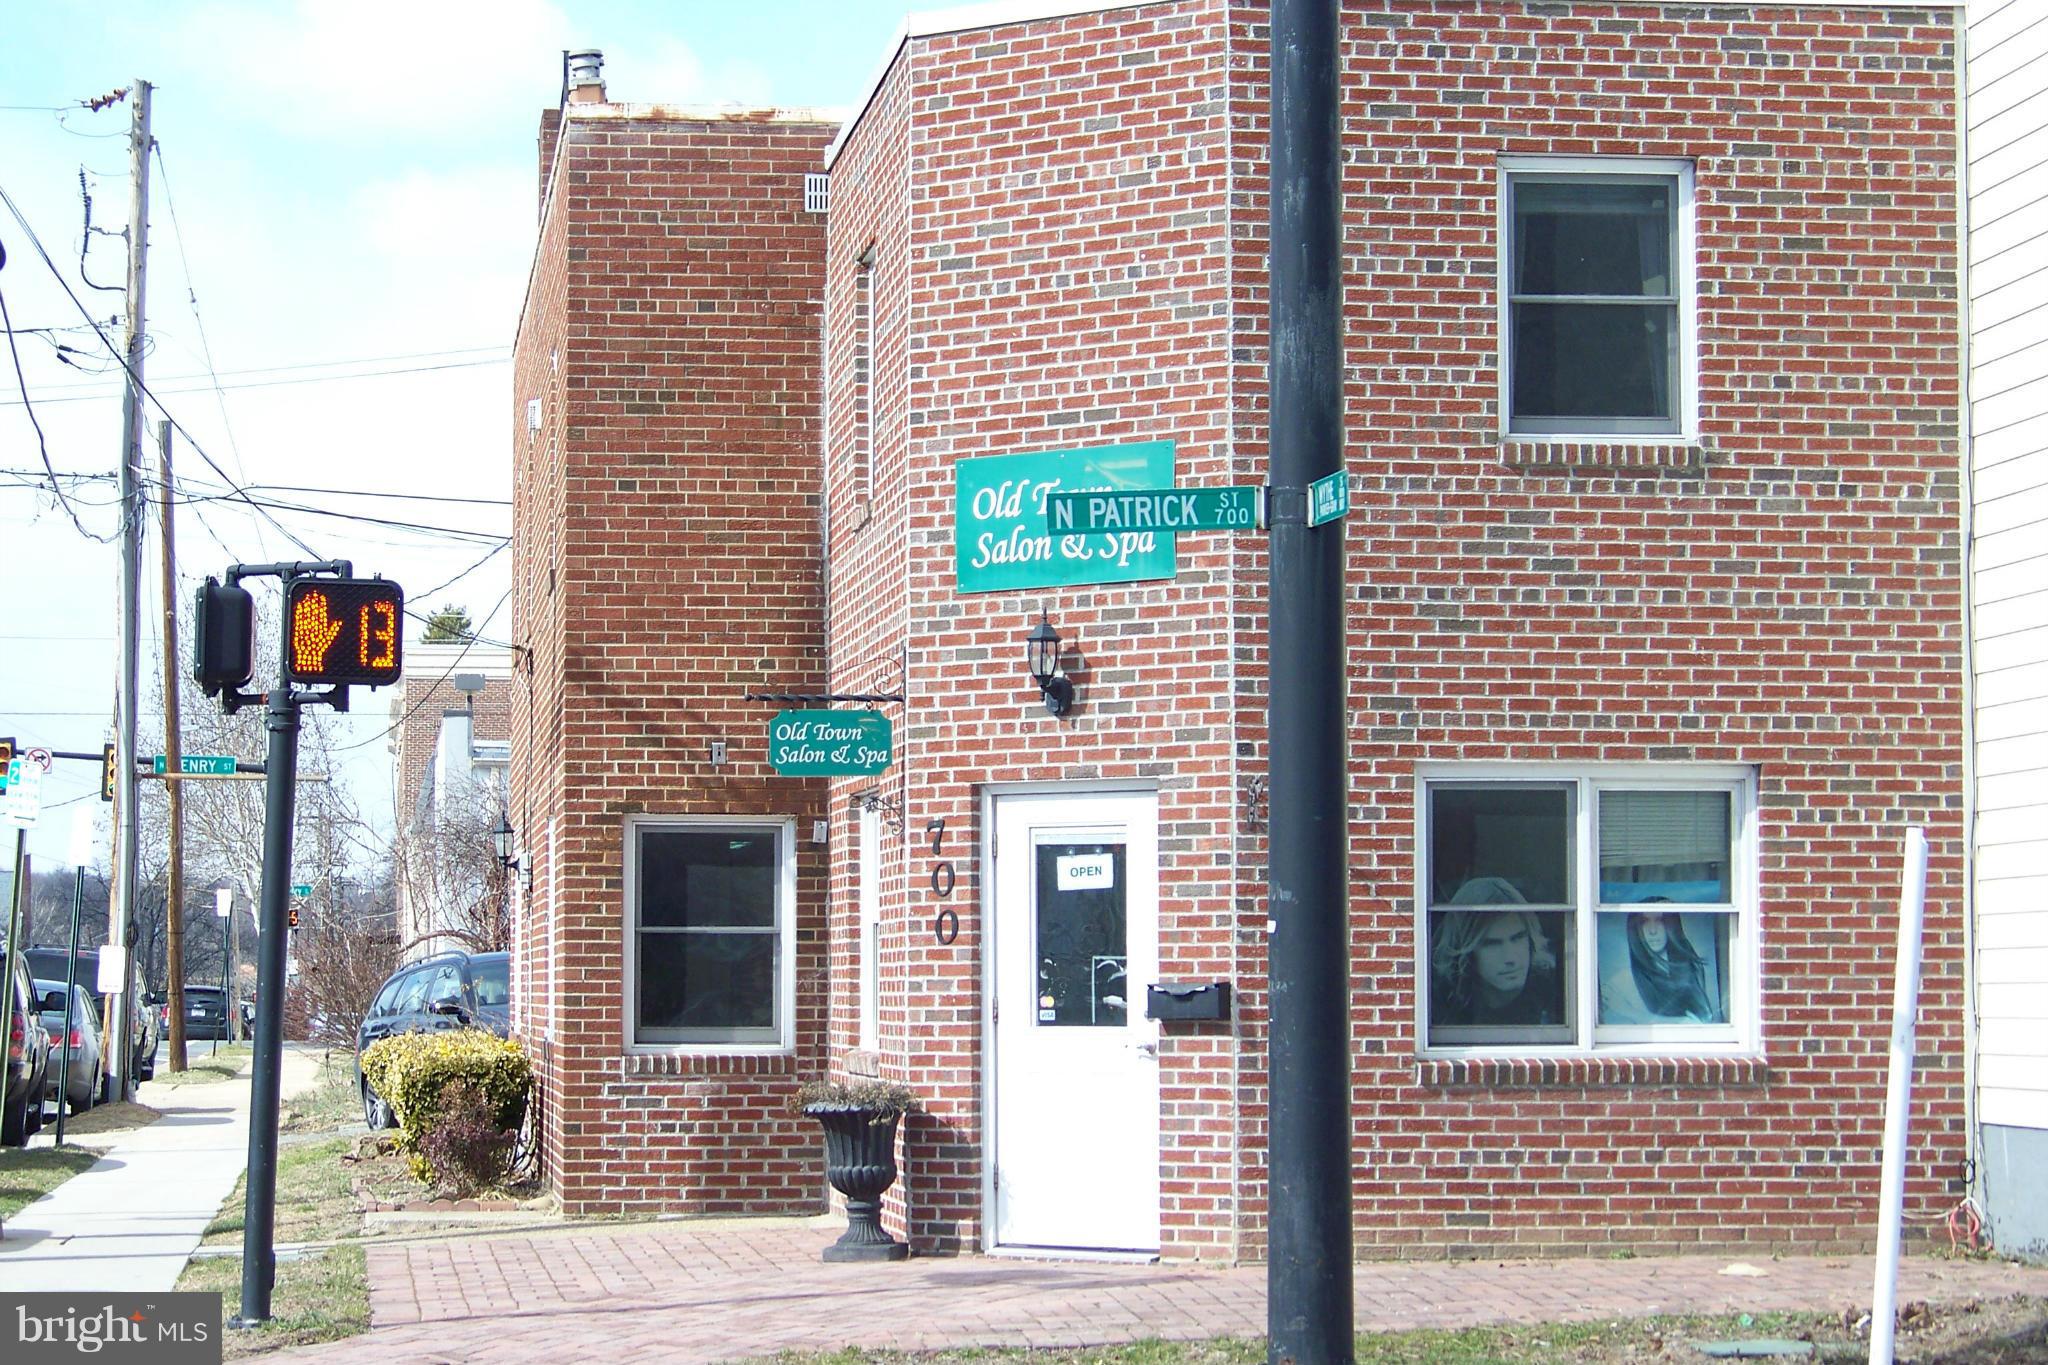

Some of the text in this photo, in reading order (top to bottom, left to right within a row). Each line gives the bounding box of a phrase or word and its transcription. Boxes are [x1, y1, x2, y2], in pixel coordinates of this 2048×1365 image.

[972, 478, 1030, 520] Old
[1219, 491, 1239, 508] ST
[1055, 498, 1073, 530] N
[1089, 494, 1199, 529] PATRICK
[1214, 508, 1249, 525] 700
[971, 524, 1053, 568] Salon
[1060, 532, 1093, 560] &
[360, 601, 394, 667] 13
[776, 721, 863, 741] Old Town
[181, 759, 217, 773] ENRY
[775, 744, 888, 769] Salon & Spa
[1070, 866, 1102, 877] OPEN
